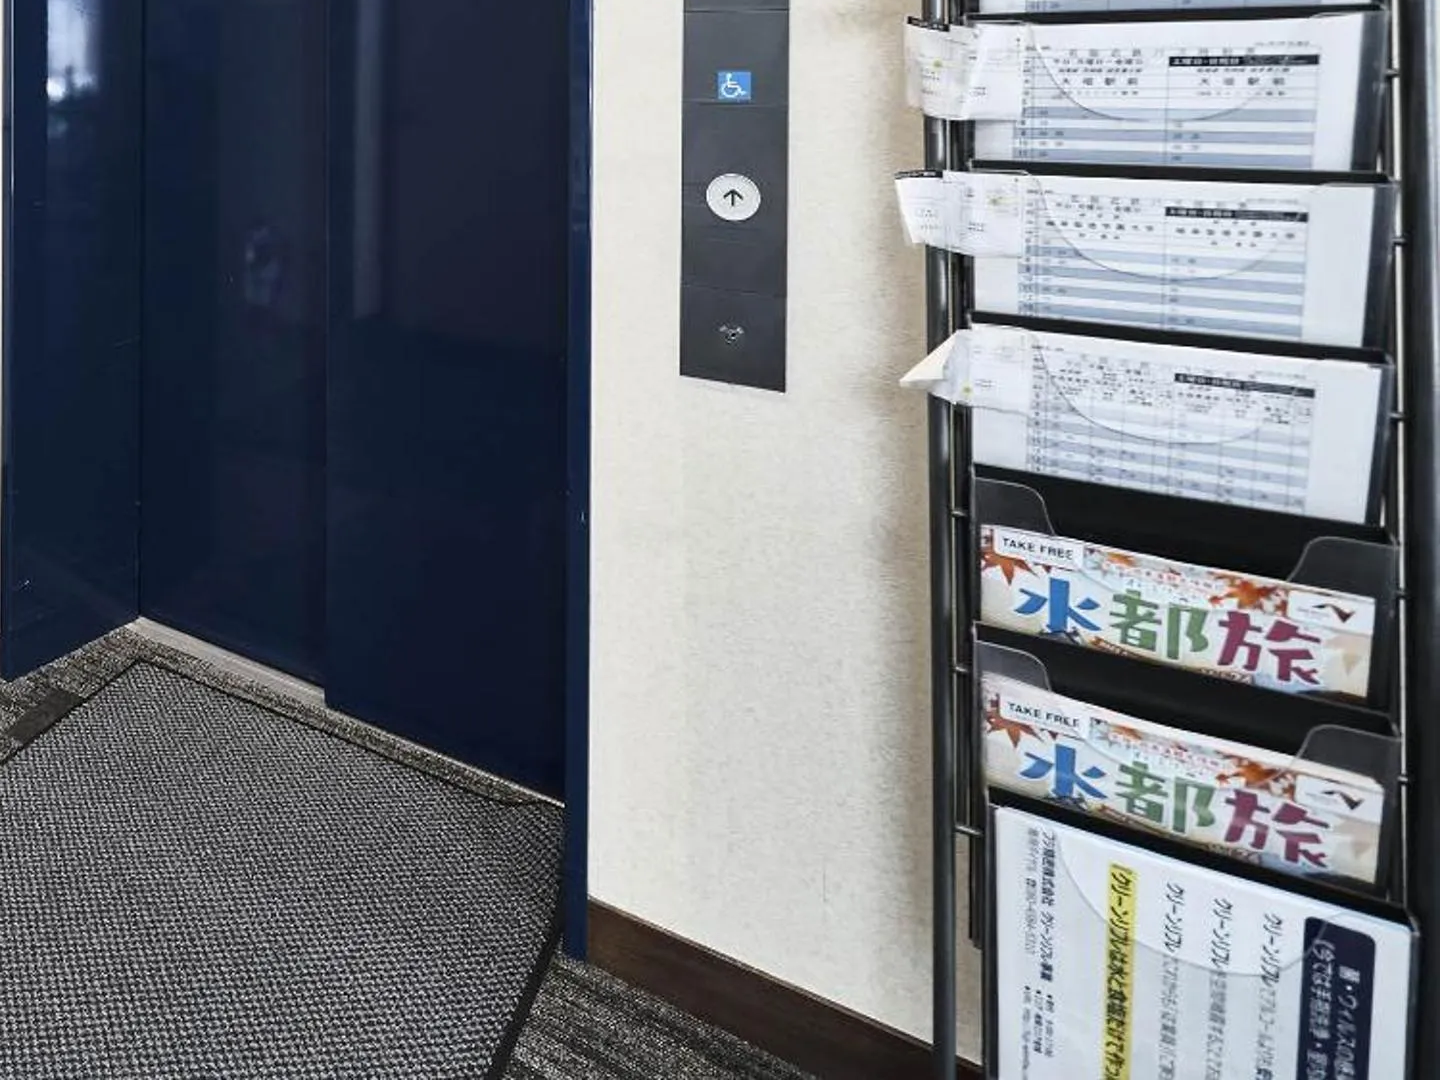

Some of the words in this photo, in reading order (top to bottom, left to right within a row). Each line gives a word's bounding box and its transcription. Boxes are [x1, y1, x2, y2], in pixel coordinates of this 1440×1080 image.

[1003, 538, 1035, 553] TAKE
[1040, 546, 1074, 561] FREE
[1014, 577, 1321, 685] 水都旅
[1008, 702, 1043, 718] TAKE
[1045, 713, 1080, 727] FREE
[1019, 743, 1330, 868] 水都旅
